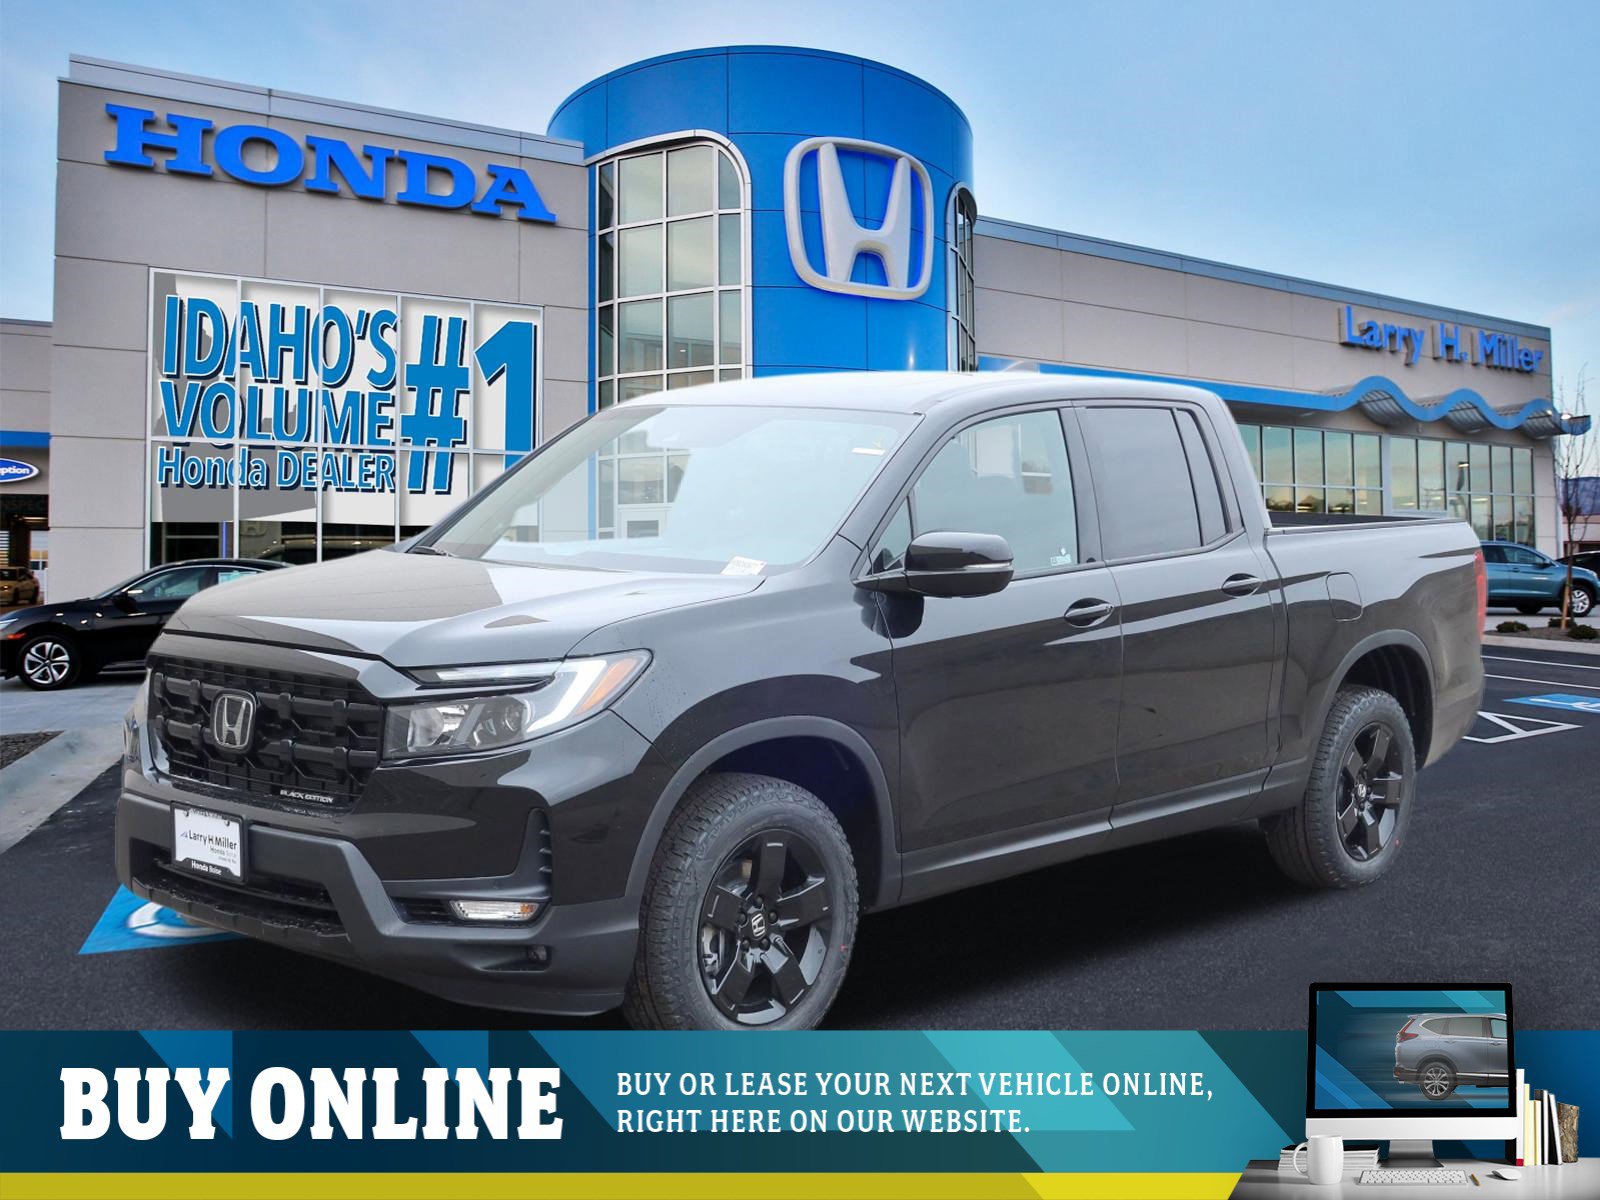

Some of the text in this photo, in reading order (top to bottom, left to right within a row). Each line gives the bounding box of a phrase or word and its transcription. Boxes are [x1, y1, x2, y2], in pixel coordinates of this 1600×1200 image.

[104, 103, 557, 224] HONDA
[162, 294, 398, 390] IDAHO'S
[1341, 305, 1544, 373] Larry H. Miller
[159, 381, 395, 449] VOLUME
[400, 315, 537, 494] #1
[0, 466, 30, 475] ption
[157, 447, 396, 492] Honda DEALER
[280, 789, 334, 803] BLACK EDITION
[188, 829, 237, 850] Larry H Miller
[191, 860, 208, 872] Honda
